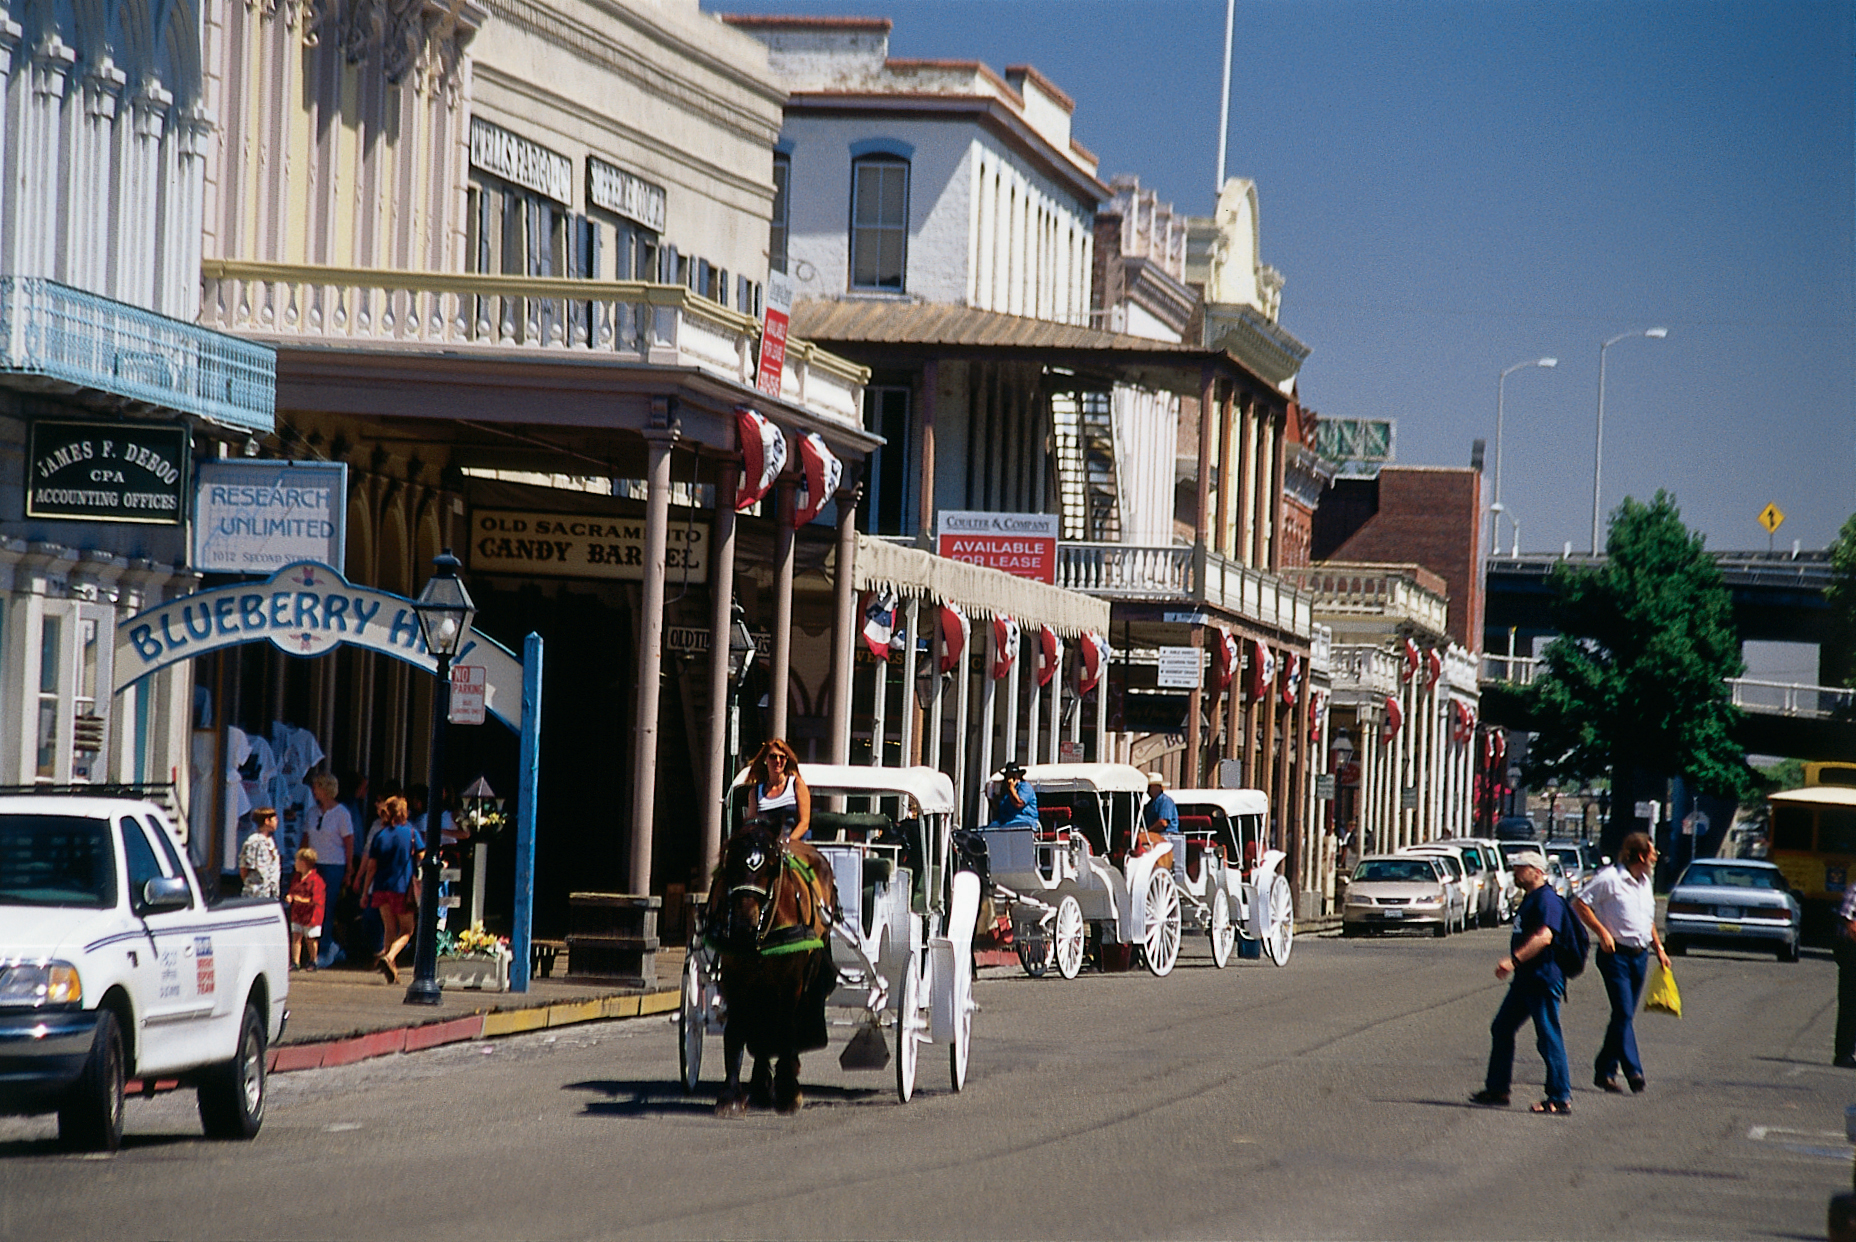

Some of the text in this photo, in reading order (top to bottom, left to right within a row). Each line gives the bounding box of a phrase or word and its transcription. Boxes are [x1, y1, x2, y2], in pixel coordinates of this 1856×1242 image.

[37, 440, 179, 485] JAMES F. DEBOO
[90, 470, 124, 483] CPA
[36, 488, 178, 511] ACCOUNTING OFFICES
[211, 486, 329, 509] RESEARCH
[220, 517, 335, 539] UNLIMITED
[480, 517, 702, 543] OLD SACRAMTO
[947, 516, 1050, 531] COULTER & COMPANY
[478, 538, 700, 569] CANDY BAREL
[952, 541, 1045, 555] AVAILABLE
[990, 556, 1042, 568] LEASE
[130, 591, 381, 663] BLUEBERRY
[856, 650, 904, 665] WELS
[454, 668, 469, 682] NO
[452, 683, 483, 694] PARKING
